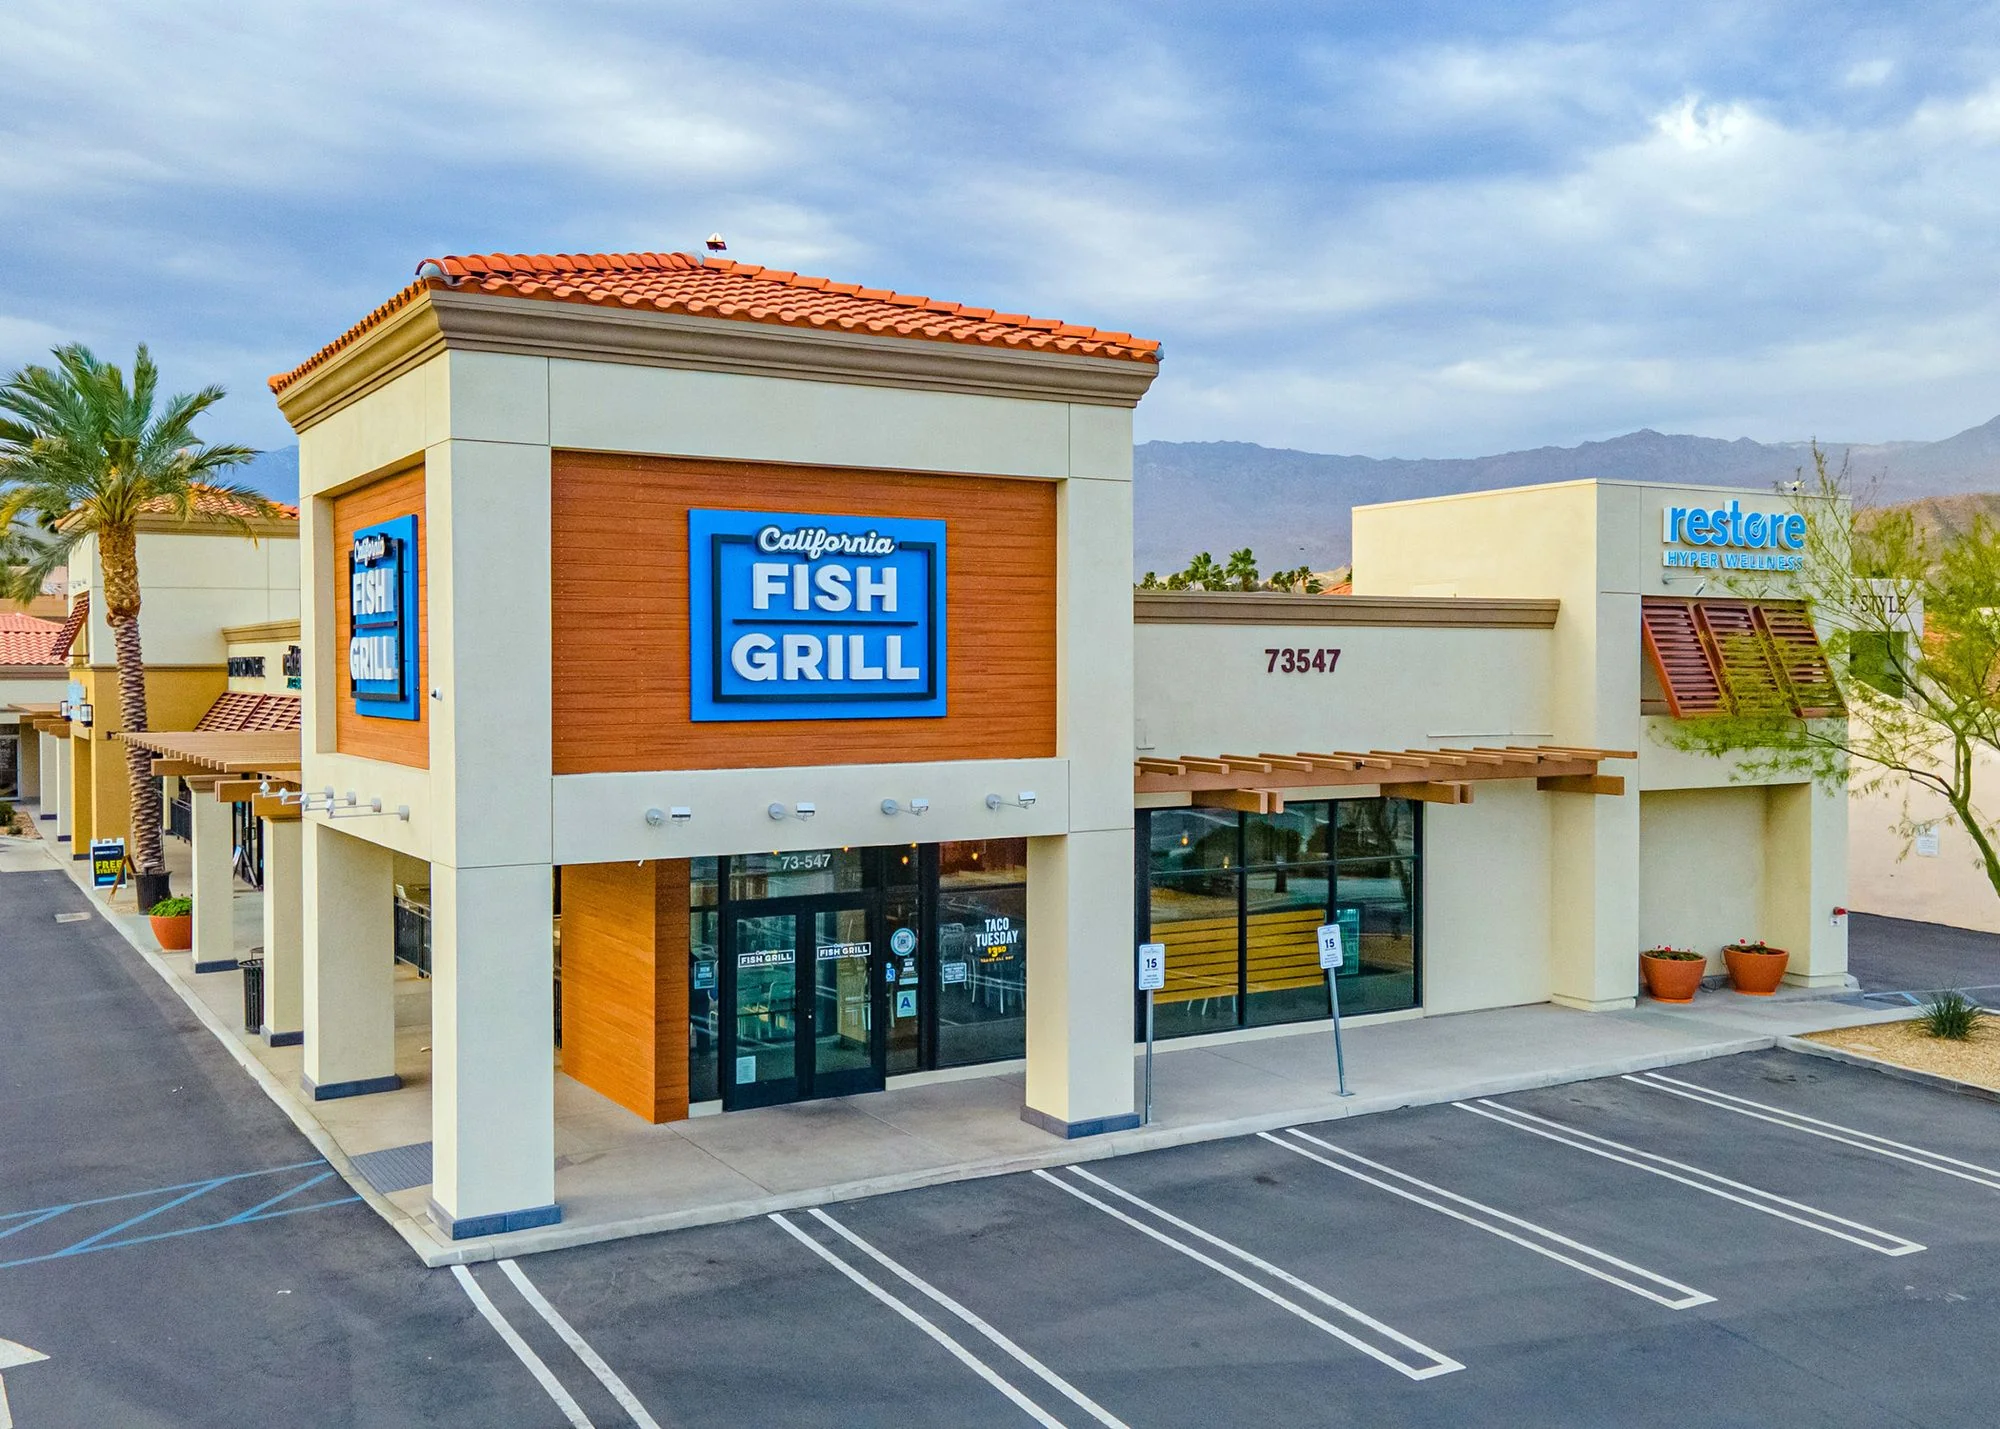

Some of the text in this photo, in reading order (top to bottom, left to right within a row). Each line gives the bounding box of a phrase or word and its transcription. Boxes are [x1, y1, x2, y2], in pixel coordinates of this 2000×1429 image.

[1664, 499, 1806, 549] restore
[758, 527, 895, 560] California
[1665, 551, 1803, 571] HYPER WELLNESS
[353, 568, 394, 616] FISH
[753, 563, 897, 612] FISH
[350, 636, 397, 680] GRILL
[731, 633, 920, 681] GRILL
[1265, 648, 1341, 673] 73547
[781, 853, 831, 870] 73-547
[985, 917, 1010, 932] TACO
[976, 930, 1019, 947] TUESDAY
[1325, 938, 1335, 948] 15
[741, 953, 792, 964] FISH GRILL
[820, 944, 868, 957] FISH GRILL
[1146, 958, 1157, 968] 15
[901, 996, 912, 1009] A
